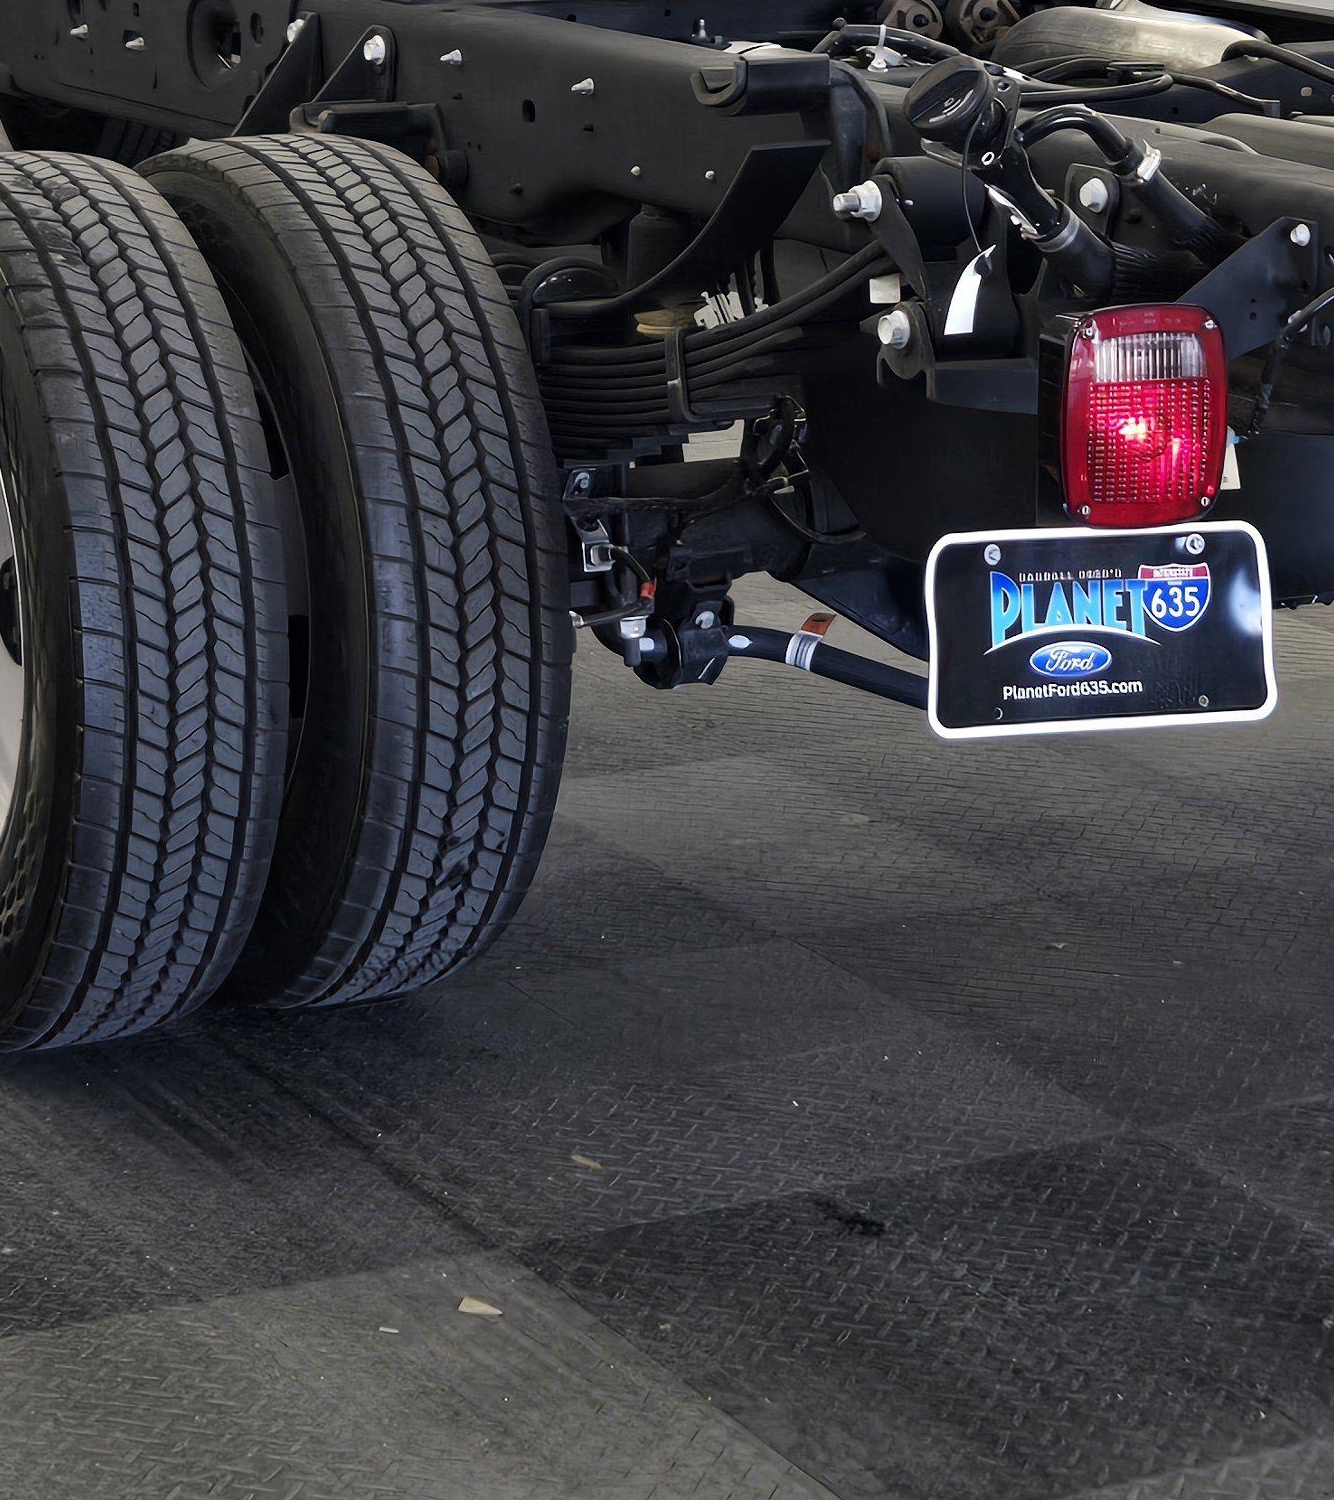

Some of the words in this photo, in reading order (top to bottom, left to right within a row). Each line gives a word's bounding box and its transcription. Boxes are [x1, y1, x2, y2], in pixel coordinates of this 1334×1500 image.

[990, 571, 1148, 648] PLANET
[1151, 586, 1200, 619] 635
[1045, 649, 1097, 672] Ford
[1002, 679, 1143, 701] PlanetFord635.com
